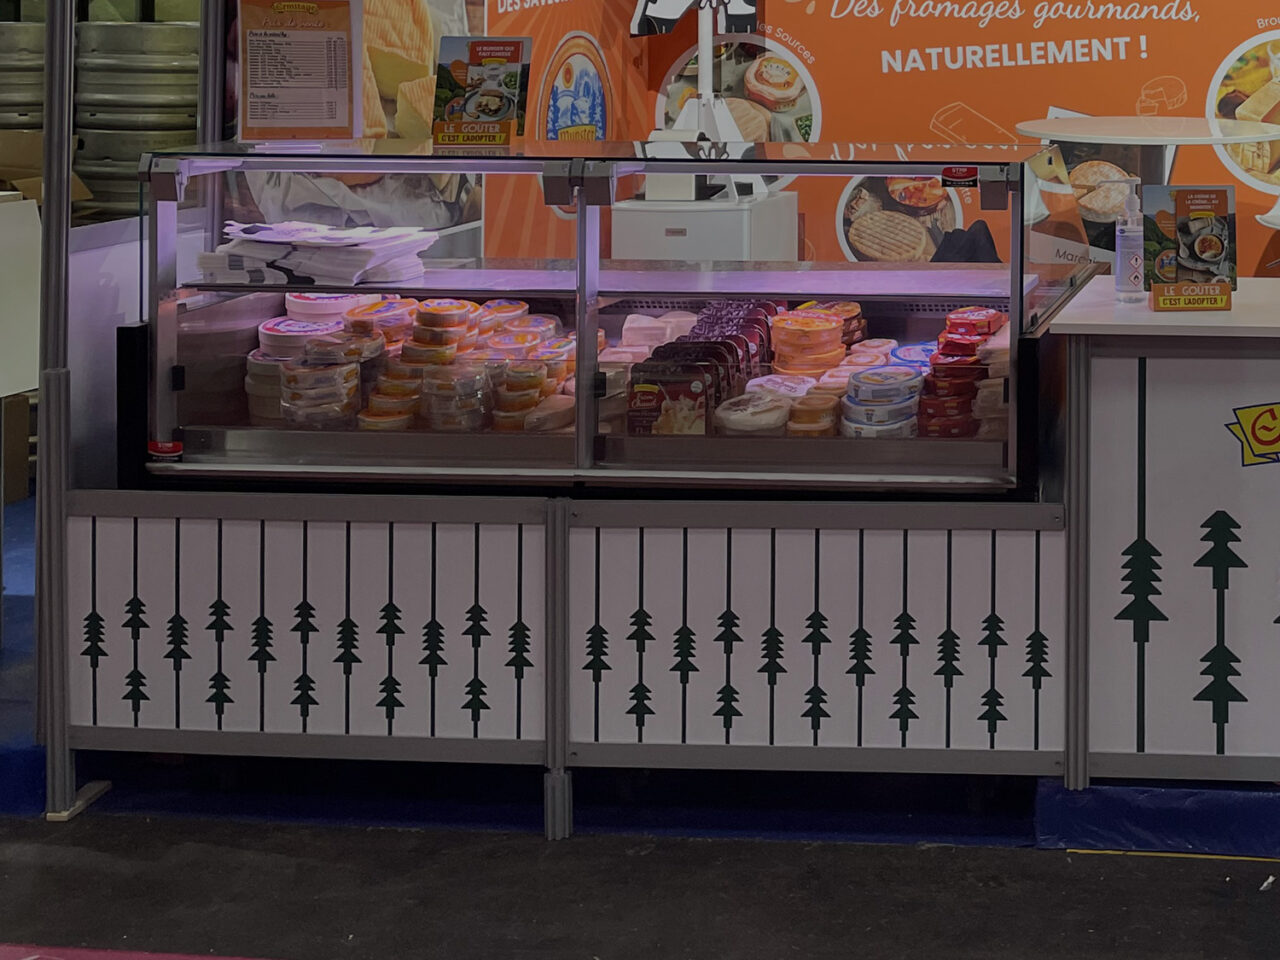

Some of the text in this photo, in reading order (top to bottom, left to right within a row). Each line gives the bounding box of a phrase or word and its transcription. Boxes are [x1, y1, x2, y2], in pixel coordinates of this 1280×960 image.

[775, 27, 816, 66] Sources
[880, 36, 1131, 74] NATURELLEMENT
[444, 123, 455, 133] LE
[1164, 286, 1175, 296] LE
[1162, 297, 1181, 306] C'EST
